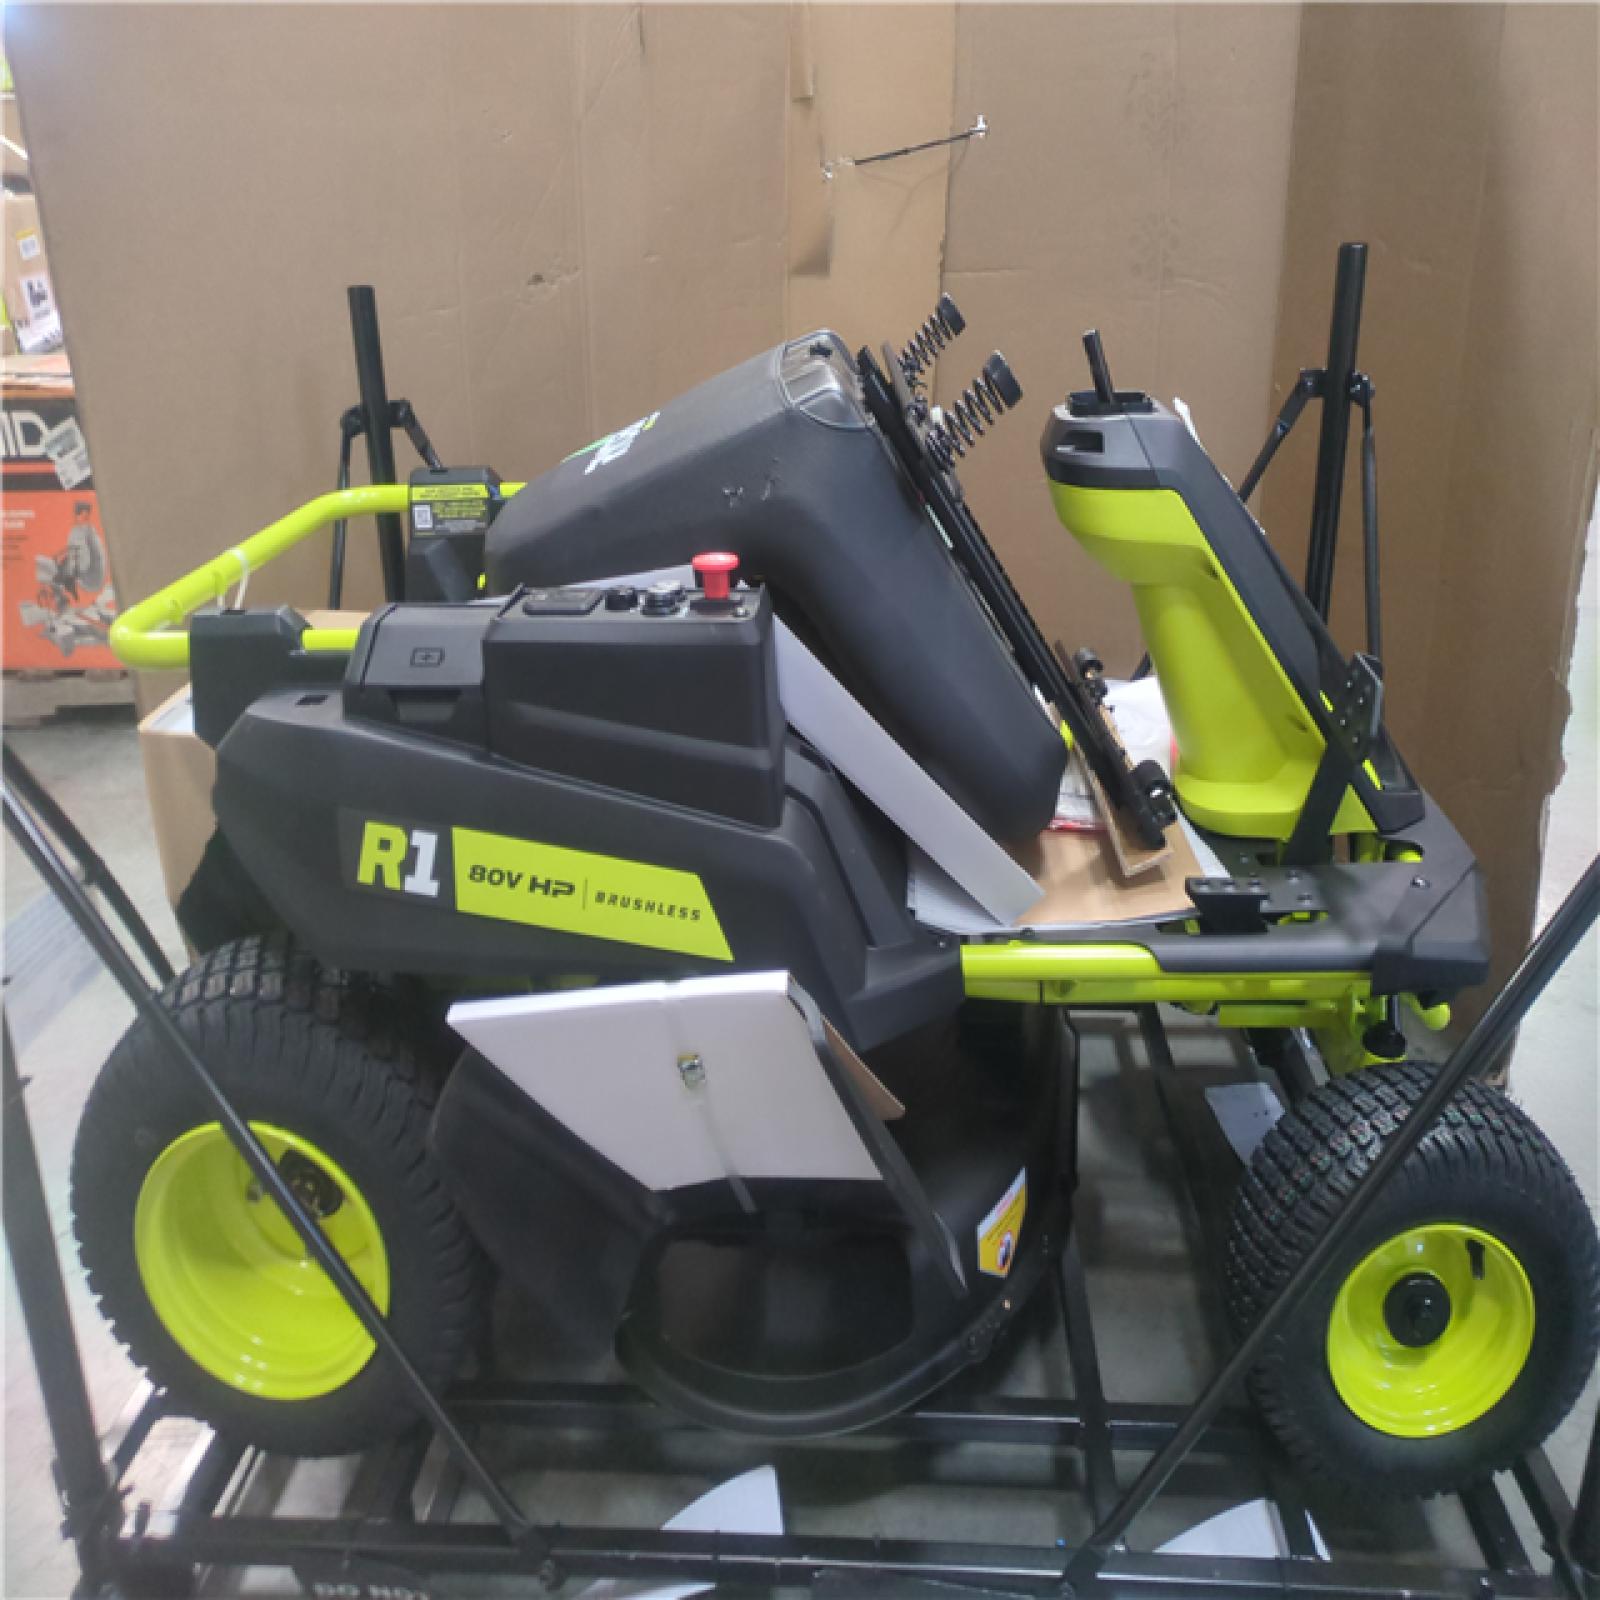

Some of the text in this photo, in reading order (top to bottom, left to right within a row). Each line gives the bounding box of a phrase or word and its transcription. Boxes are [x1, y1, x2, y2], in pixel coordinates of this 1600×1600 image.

[357, 821, 440, 897] R1
[469, 865, 701, 921] 80V HP BRUSHLESS
